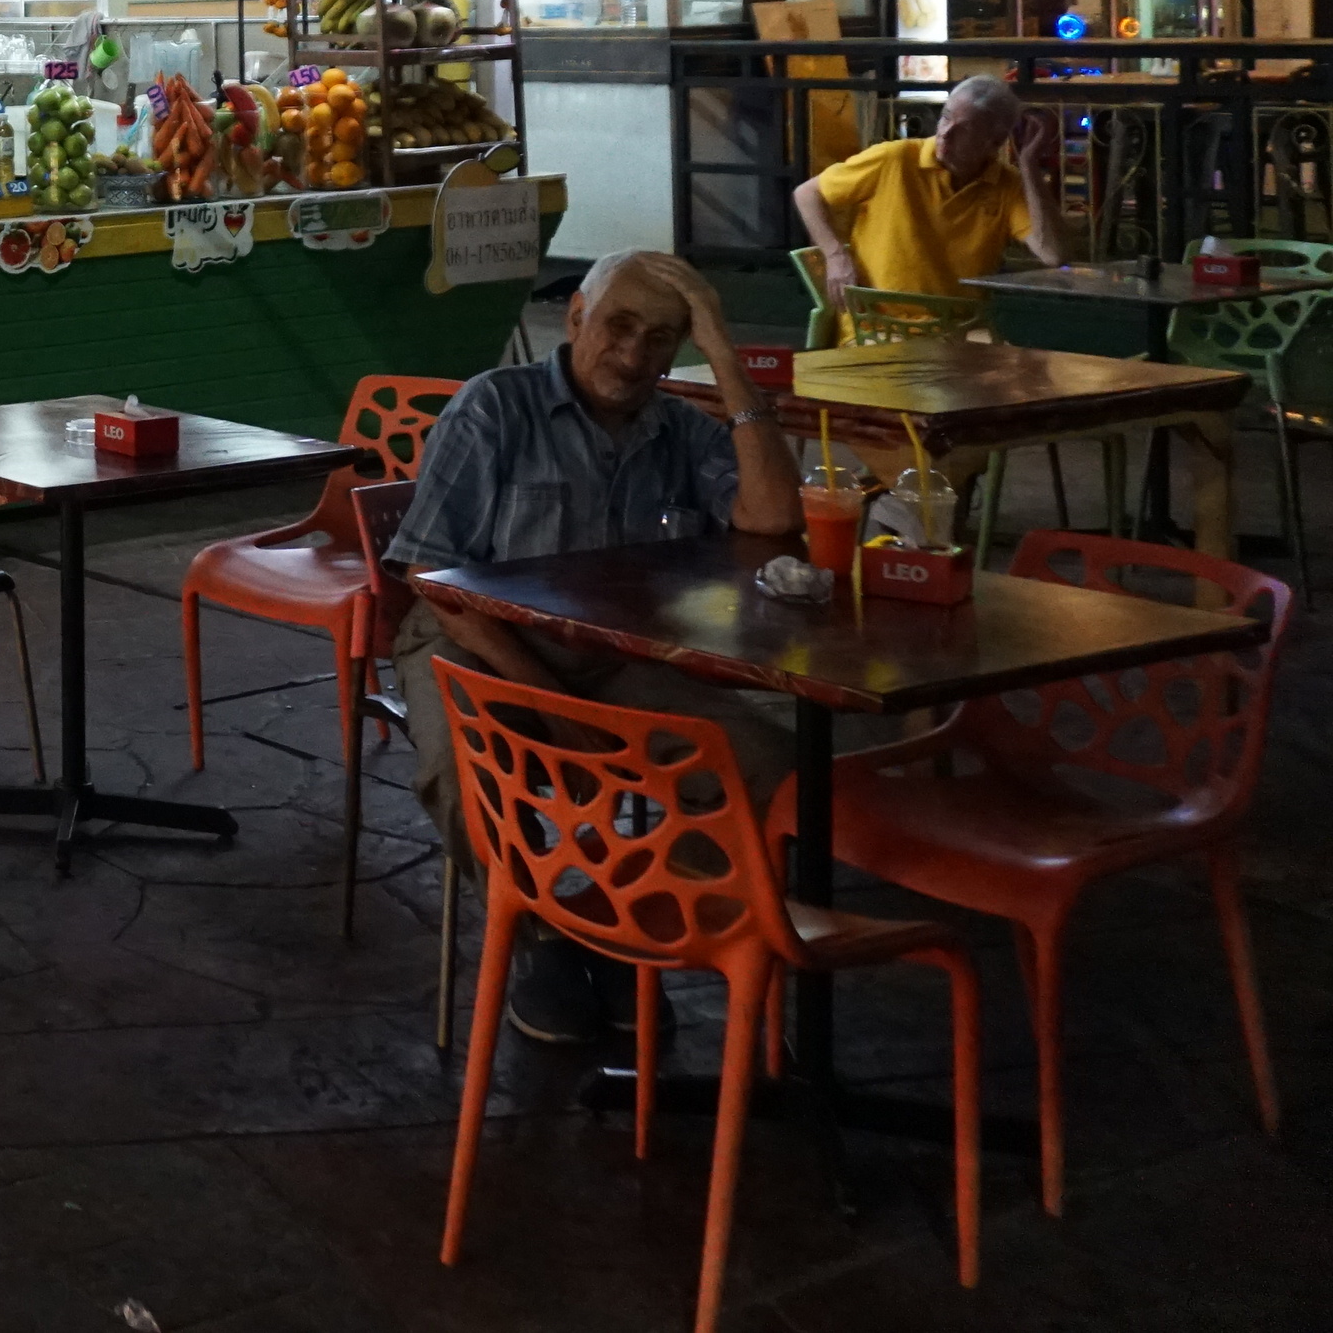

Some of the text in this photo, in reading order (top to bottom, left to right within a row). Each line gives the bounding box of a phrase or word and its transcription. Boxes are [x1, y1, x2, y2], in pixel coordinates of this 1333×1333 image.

[46, 63, 78, 79] 125
[290, 66, 321, 86] 150
[10, 181, 28, 193] 20
[748, 356, 779, 368] LEO
[104, 424, 125, 440] LEO
[882, 562, 929, 583] LEO
